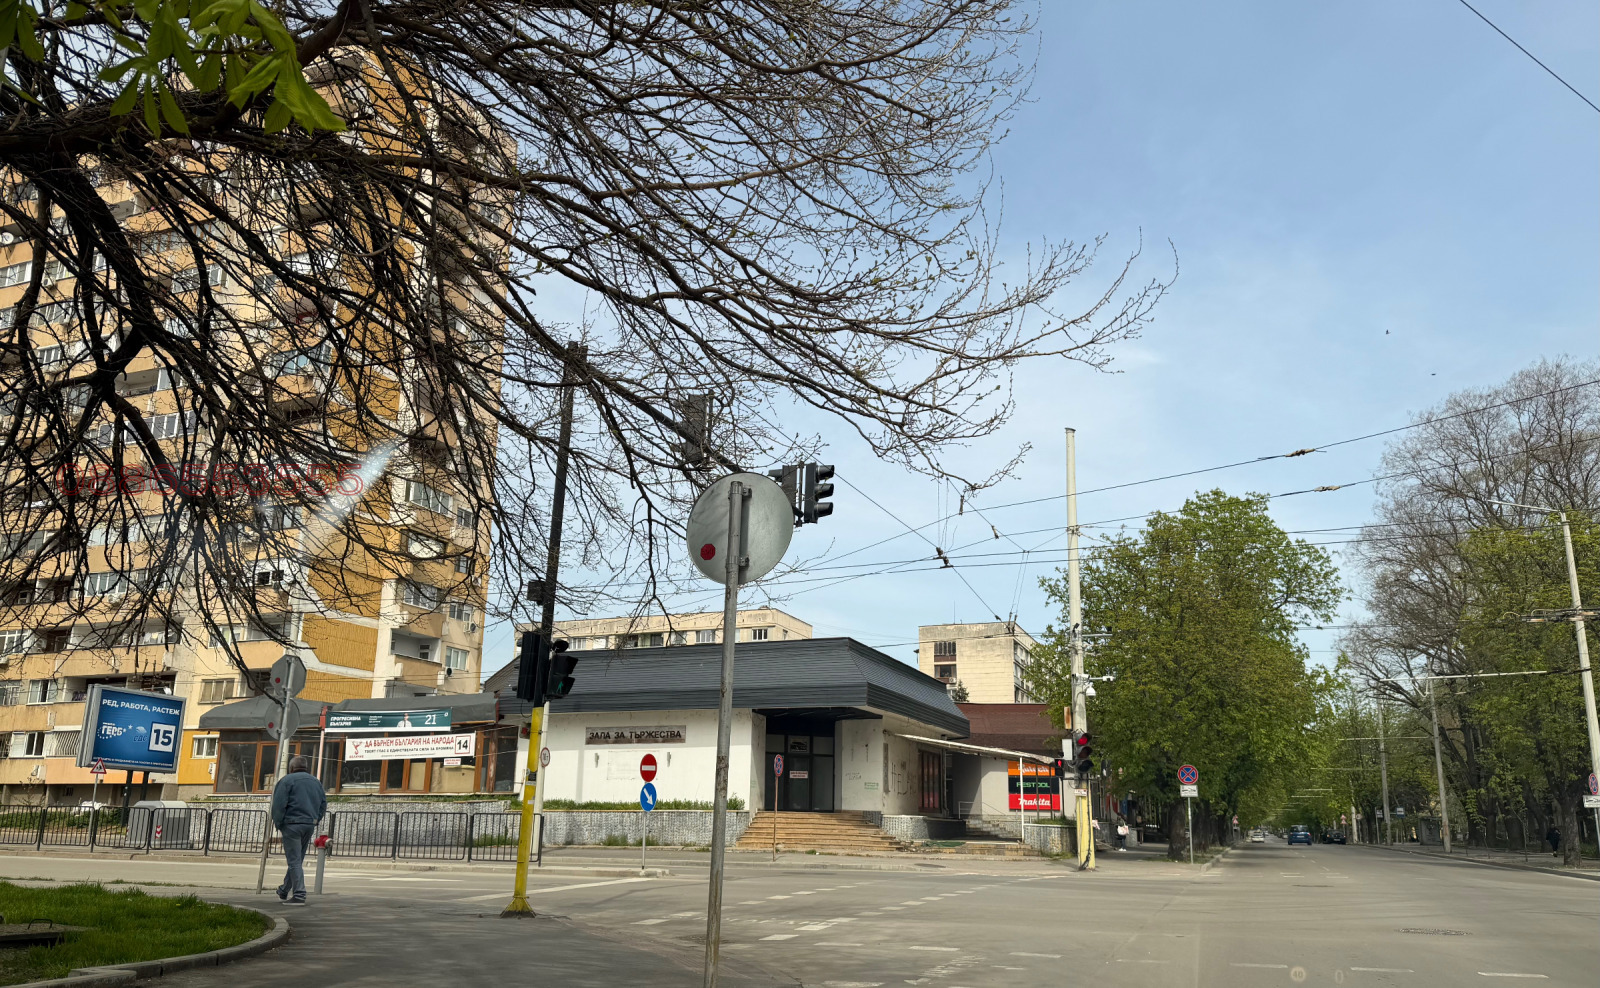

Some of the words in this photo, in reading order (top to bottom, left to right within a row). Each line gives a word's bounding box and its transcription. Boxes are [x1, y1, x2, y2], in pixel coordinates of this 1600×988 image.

[102, 699, 119, 708] РЕД,
[120, 702, 151, 712] РАБОТА,
[152, 706, 180, 716] РАСТЕЖ
[424, 714, 437, 725] 21
[101, 725, 123, 736] ГЕРБ
[589, 732, 611, 740] ЗАЛА
[614, 731, 626, 739] ЗА
[153, 729, 173, 746] 15
[364, 740, 373, 748] ДА
[373, 739, 394, 747] ВЪРНЕМ
[394, 737, 422, 746] БЪЛГАРИЯ
[422, 737, 431, 745] НА
[431, 736, 455, 745] НАРОДА
[457, 739, 468, 750] 14
